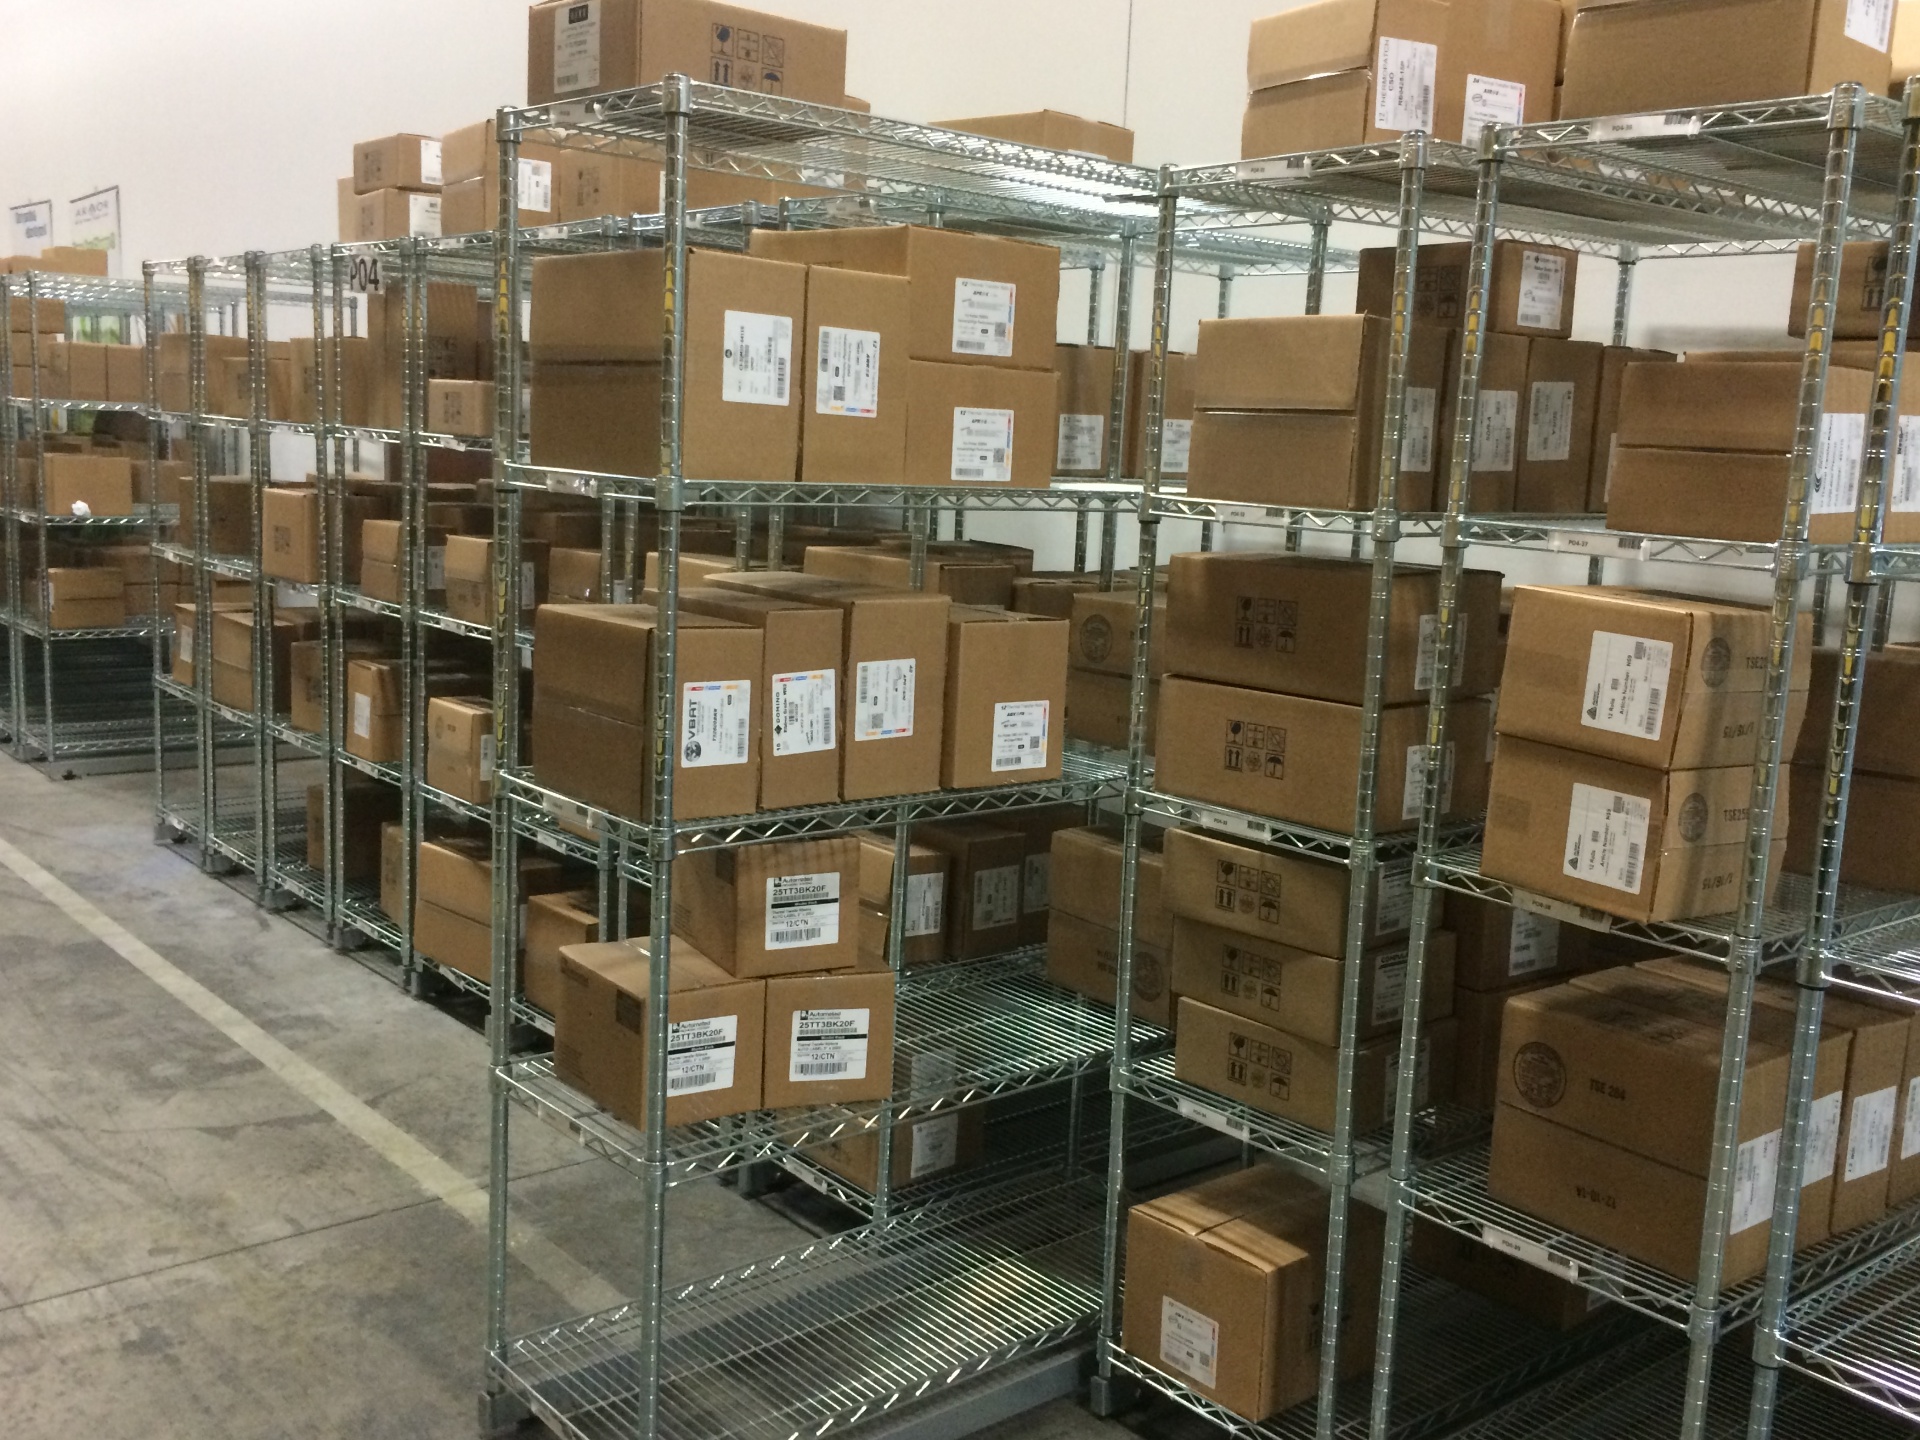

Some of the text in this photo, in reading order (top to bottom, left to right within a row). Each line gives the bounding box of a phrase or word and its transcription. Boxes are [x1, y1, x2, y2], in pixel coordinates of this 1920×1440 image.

[1379, 40, 1389, 121] 12 THERMOPATCH
[688, 699, 697, 741] VBAT
[773, 885, 826, 896] 25TT3BK20F
[681, 1020, 711, 1029] Automated
[799, 1020, 855, 1028] 25TT3BK20F
[670, 1029, 723, 1042] 25TT3BK20F
